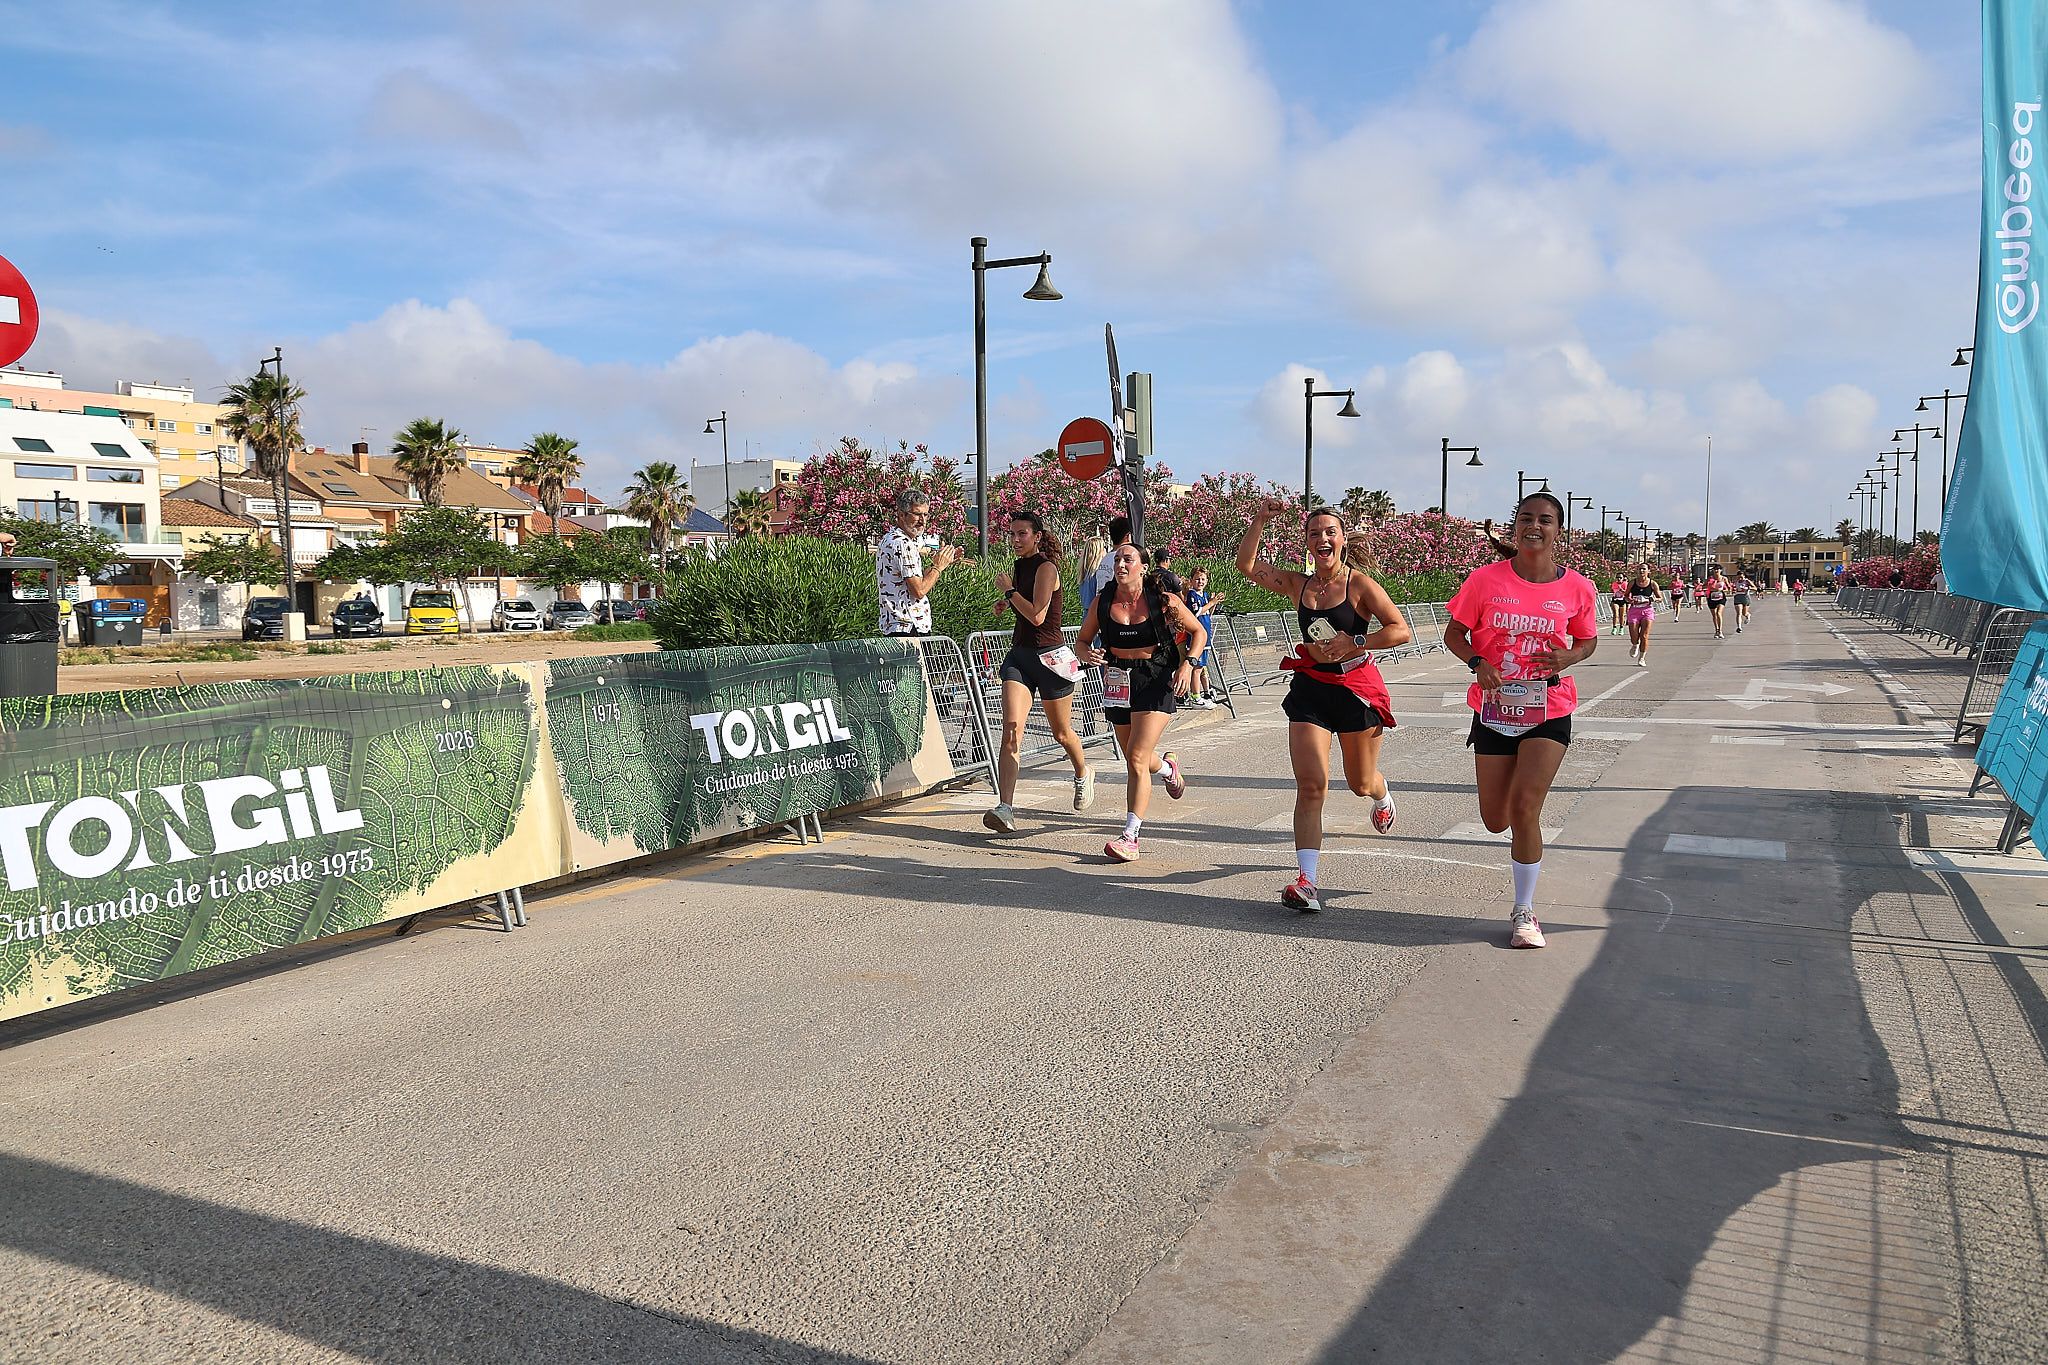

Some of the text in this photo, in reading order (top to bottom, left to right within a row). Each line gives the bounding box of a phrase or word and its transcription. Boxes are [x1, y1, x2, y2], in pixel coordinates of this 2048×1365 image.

[1493, 611, 1556, 635] CARRERA
[877, 679, 897, 693] 2026
[1108, 685, 1121, 693] 016
[592, 703, 621, 723] 1975
[1501, 705, 1525, 716] 016
[435, 730, 475, 752] 2026
[705, 751, 859, 794] Cuidando de ti desde 1975
[166, 877, 202, 908] de
[207, 870, 231, 899] ti
[236, 856, 313, 894] desde
[320, 846, 374, 877] 1975
